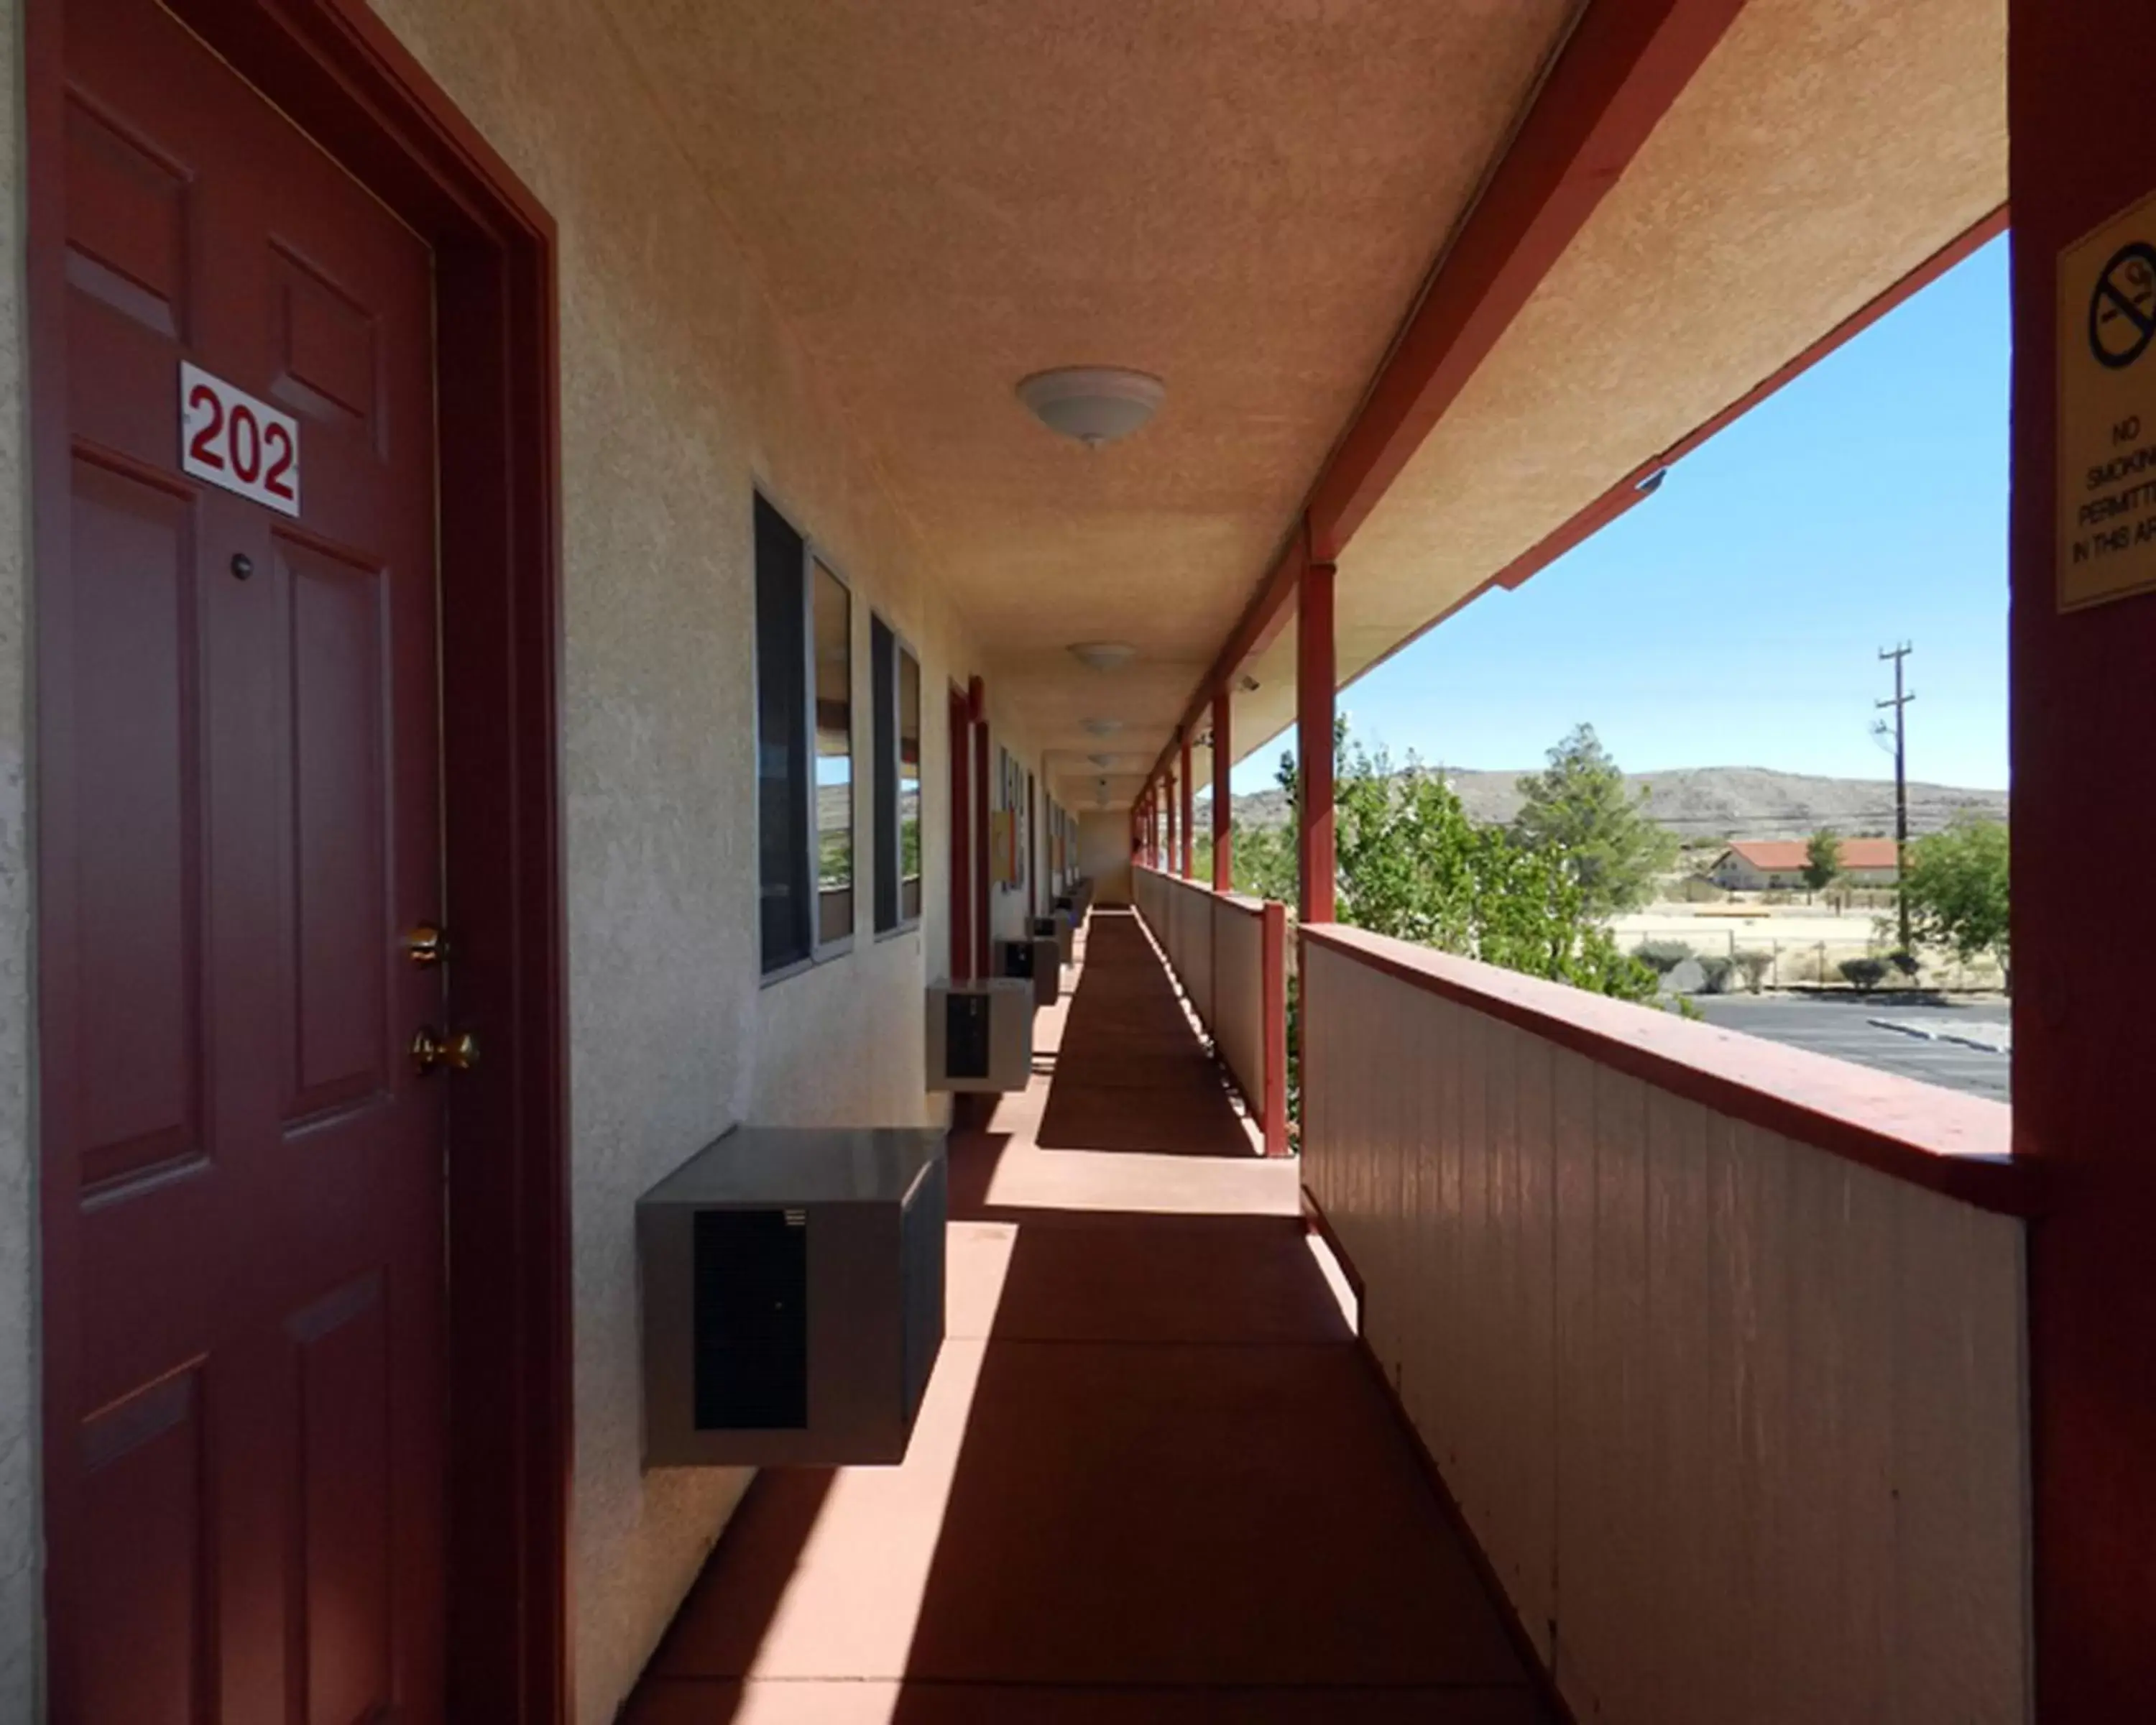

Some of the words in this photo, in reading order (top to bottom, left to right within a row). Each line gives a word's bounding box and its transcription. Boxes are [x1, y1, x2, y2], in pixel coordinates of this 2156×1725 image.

[190, 385, 292, 499] 202
[2112, 415, 2141, 446] NO
[2078, 479, 2156, 526] PERMITT
[2073, 540, 2090, 564] IN
[2092, 525, 2129, 558] THIS
